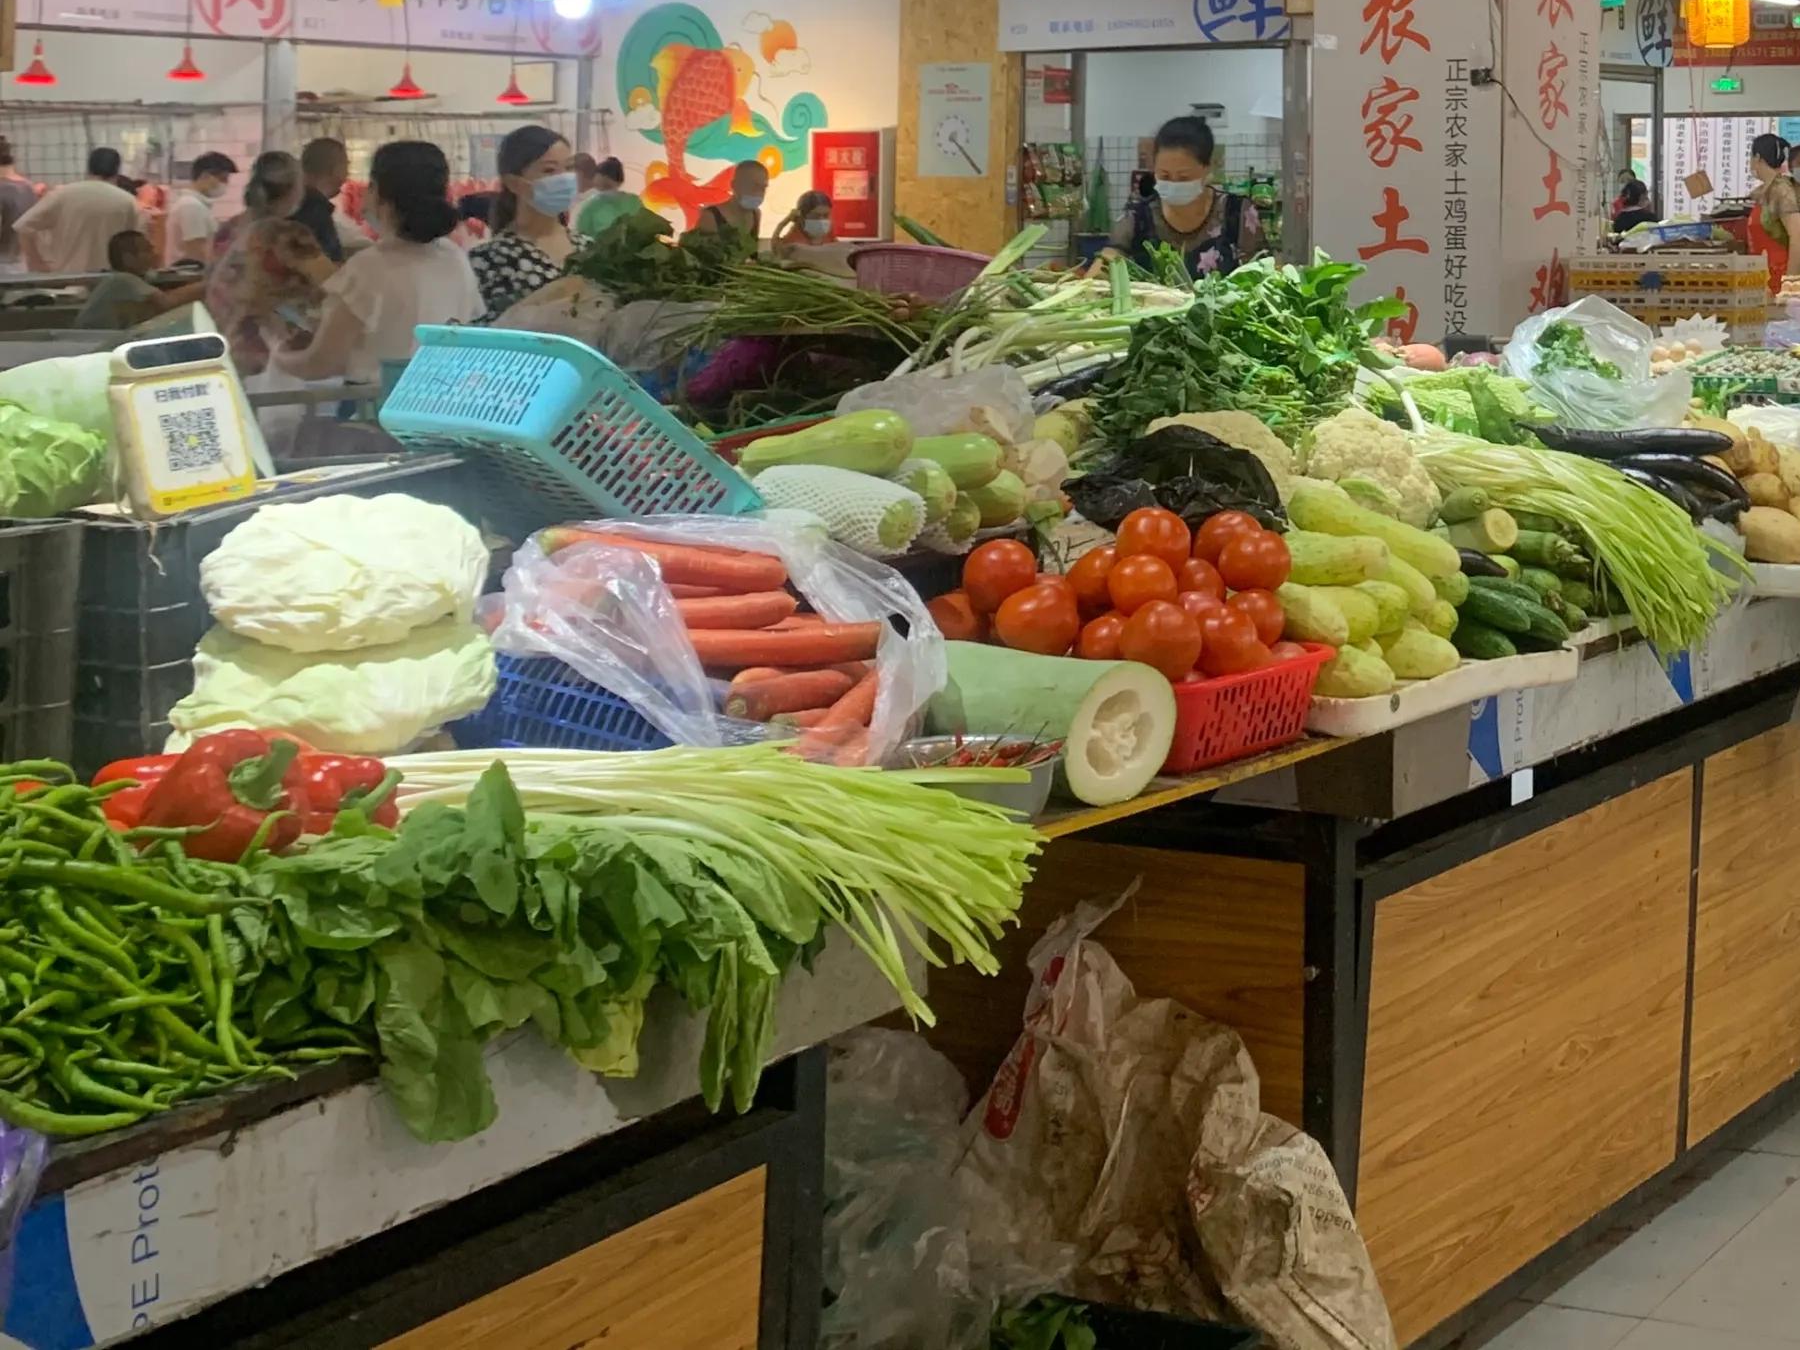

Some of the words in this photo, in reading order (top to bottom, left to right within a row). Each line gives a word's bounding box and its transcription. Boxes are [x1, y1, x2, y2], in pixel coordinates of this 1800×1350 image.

[1443, 58, 1468, 336] 正宗农家土鸡蛋好吃没
